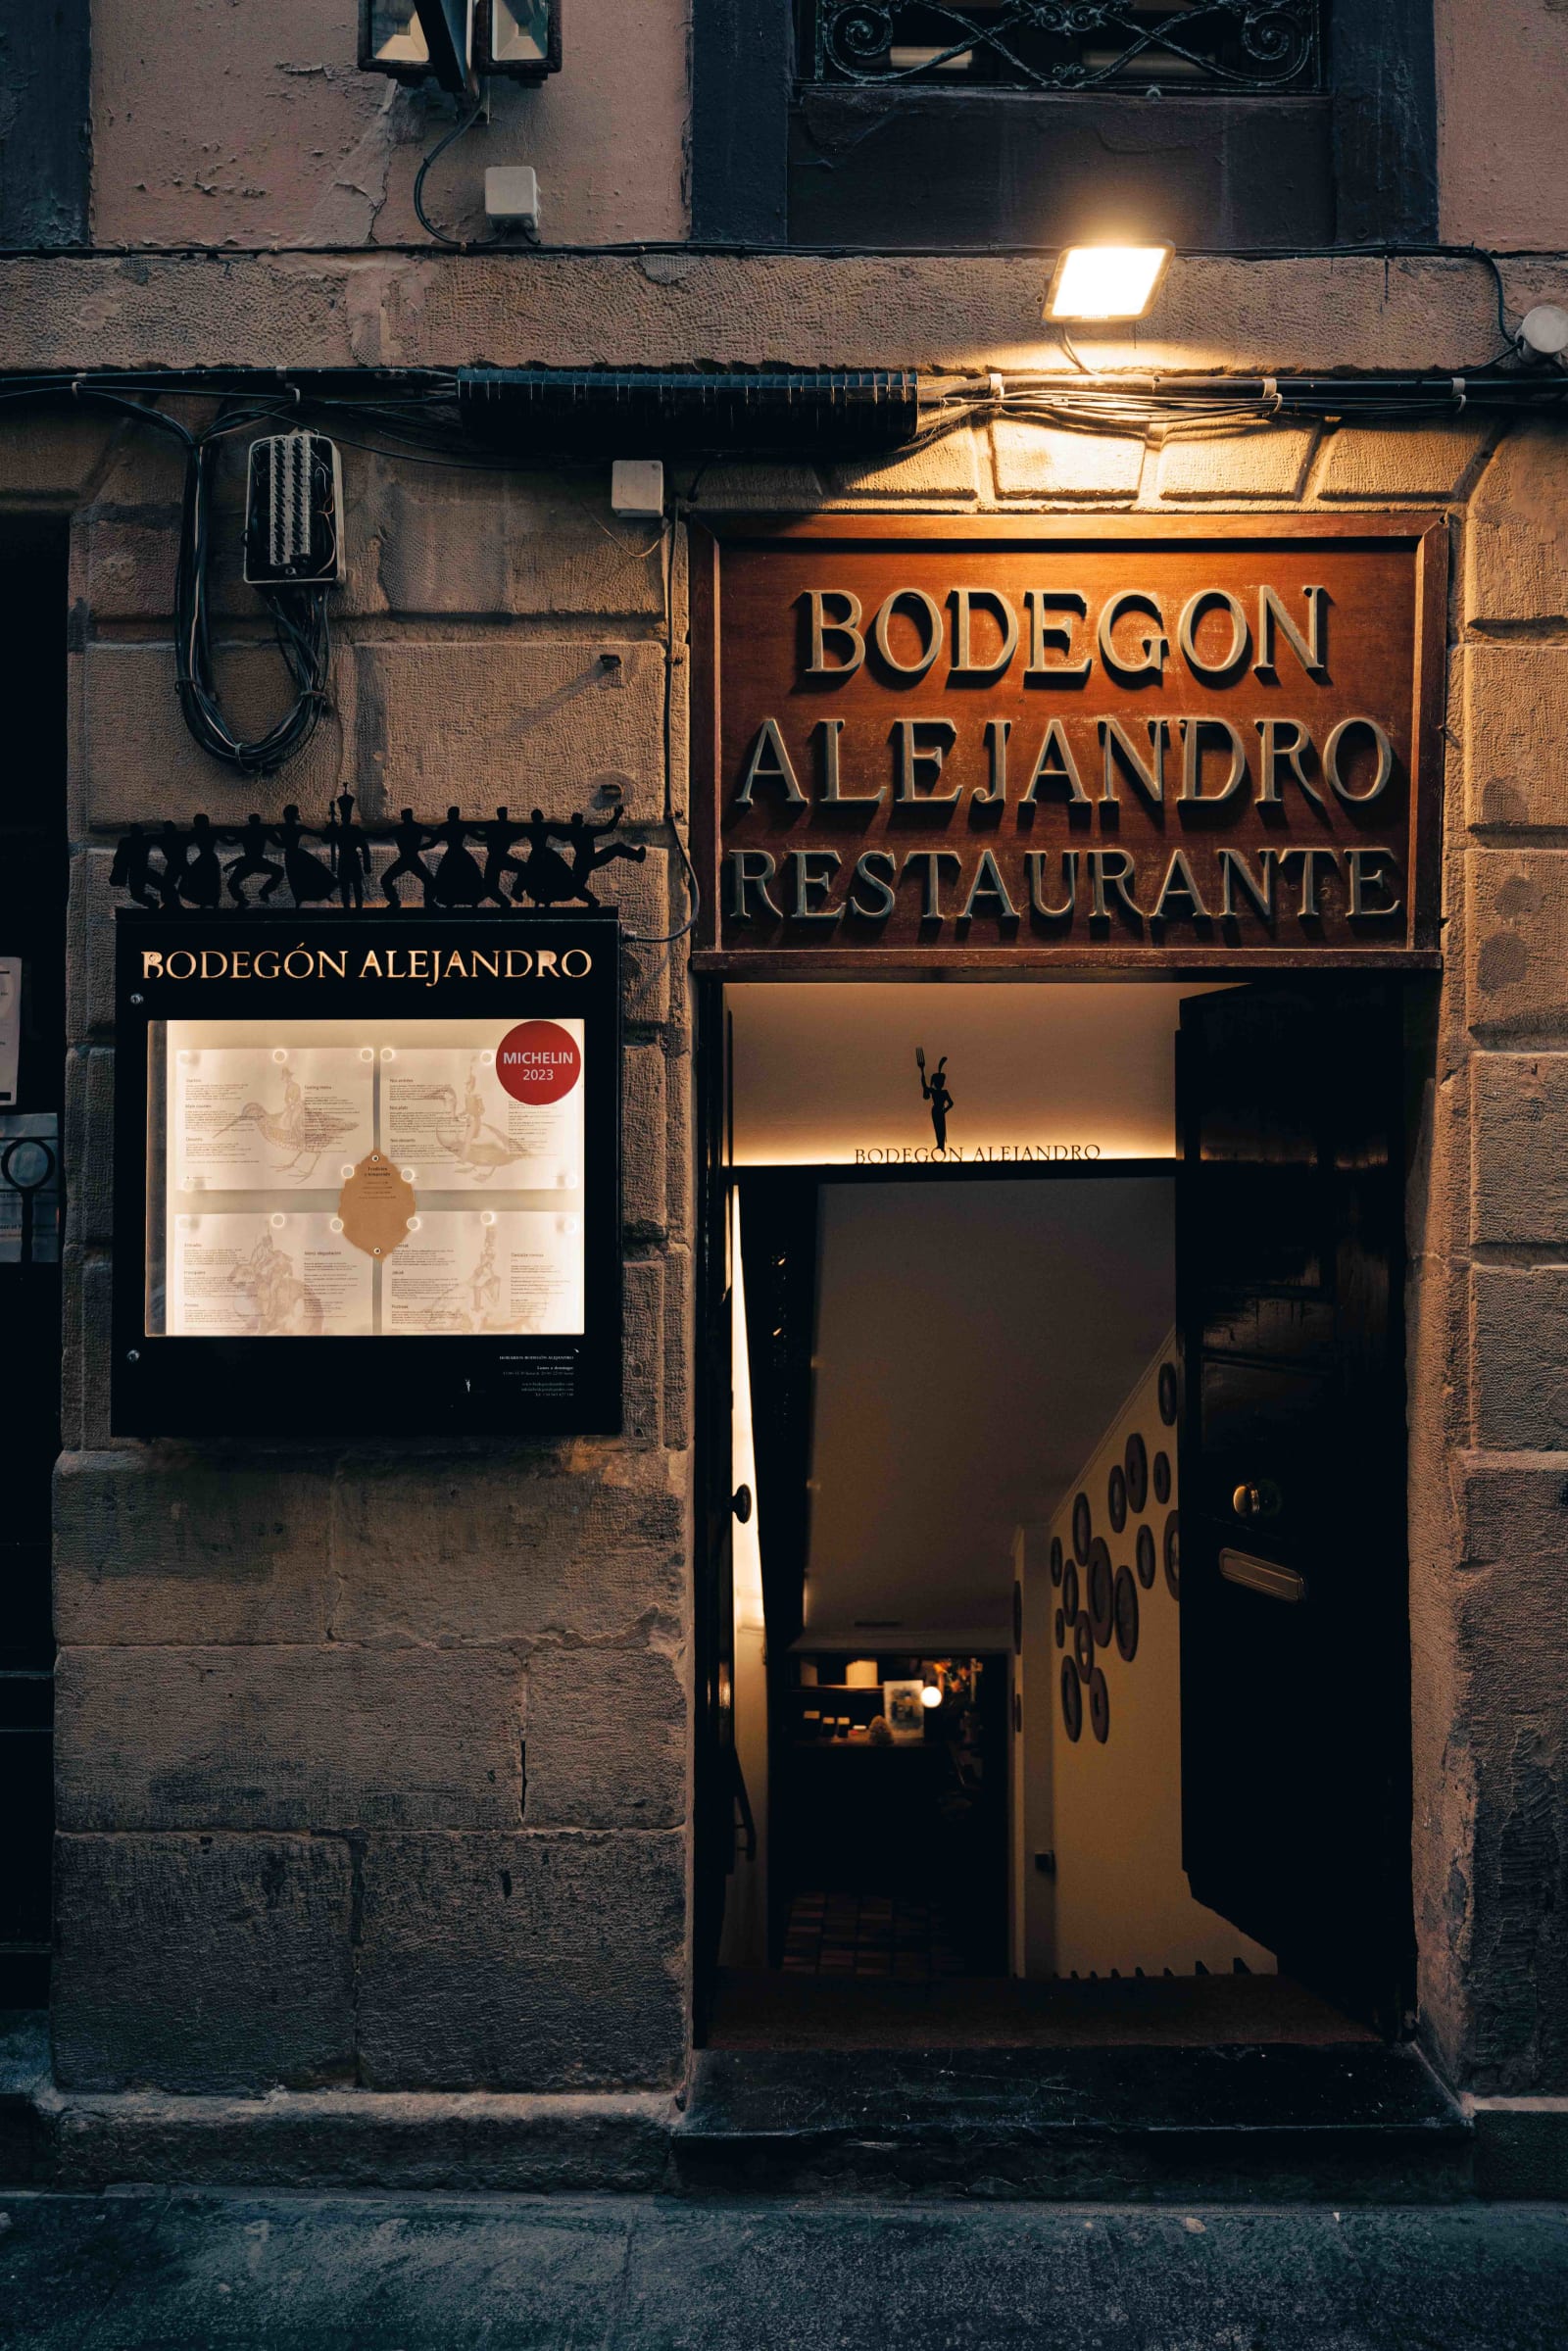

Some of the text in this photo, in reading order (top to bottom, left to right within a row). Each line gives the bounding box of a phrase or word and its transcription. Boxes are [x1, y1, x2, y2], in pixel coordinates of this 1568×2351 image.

[802, 584, 1327, 676] BODEGON
[734, 715, 1394, 808] ALEJANDRO
[726, 846, 1402, 922] RESTAURANTE
[140, 942, 594, 987] BODEGÓN ALEJANDRO
[503, 1051, 574, 1065] MICHELIN
[522, 1068, 555, 1081] 2023
